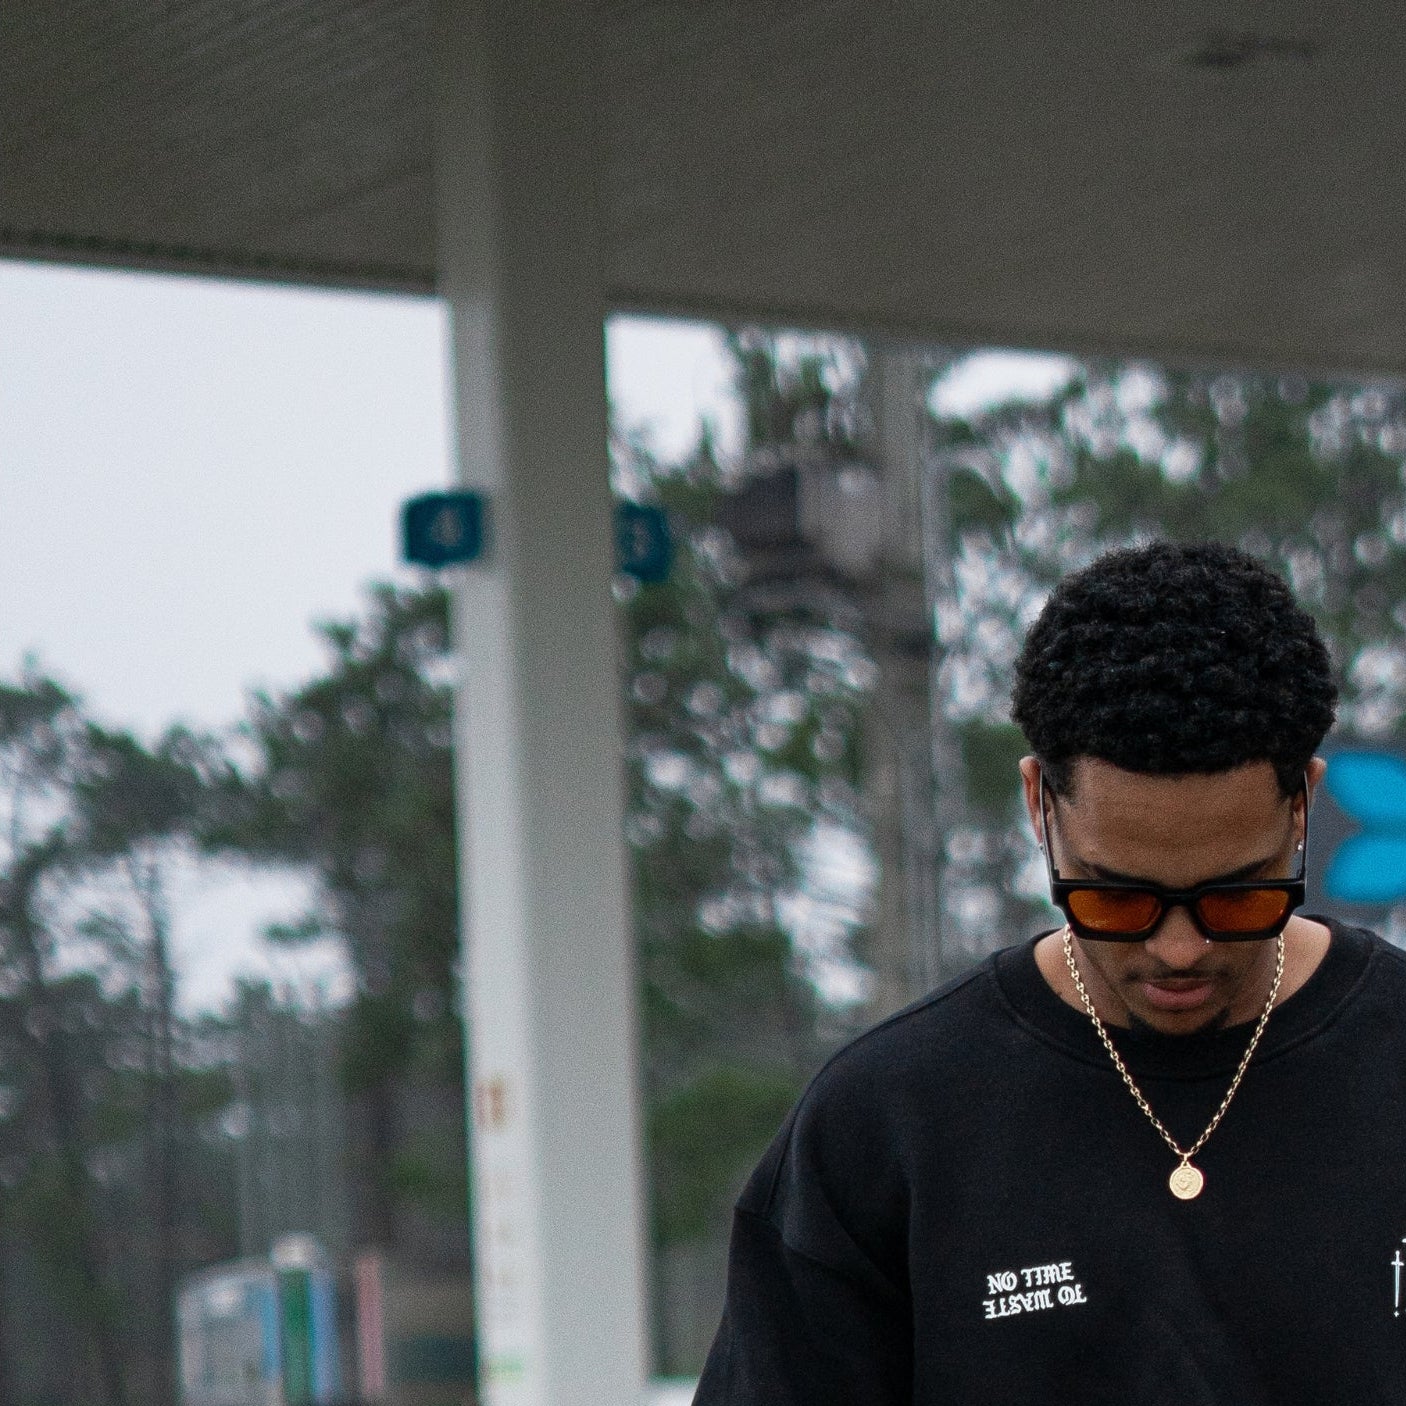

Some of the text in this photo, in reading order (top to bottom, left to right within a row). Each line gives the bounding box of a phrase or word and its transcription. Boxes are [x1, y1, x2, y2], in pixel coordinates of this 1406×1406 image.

[986, 1261, 1075, 1295] NO TIME
[982, 1283, 1088, 1320] TO WASTE
